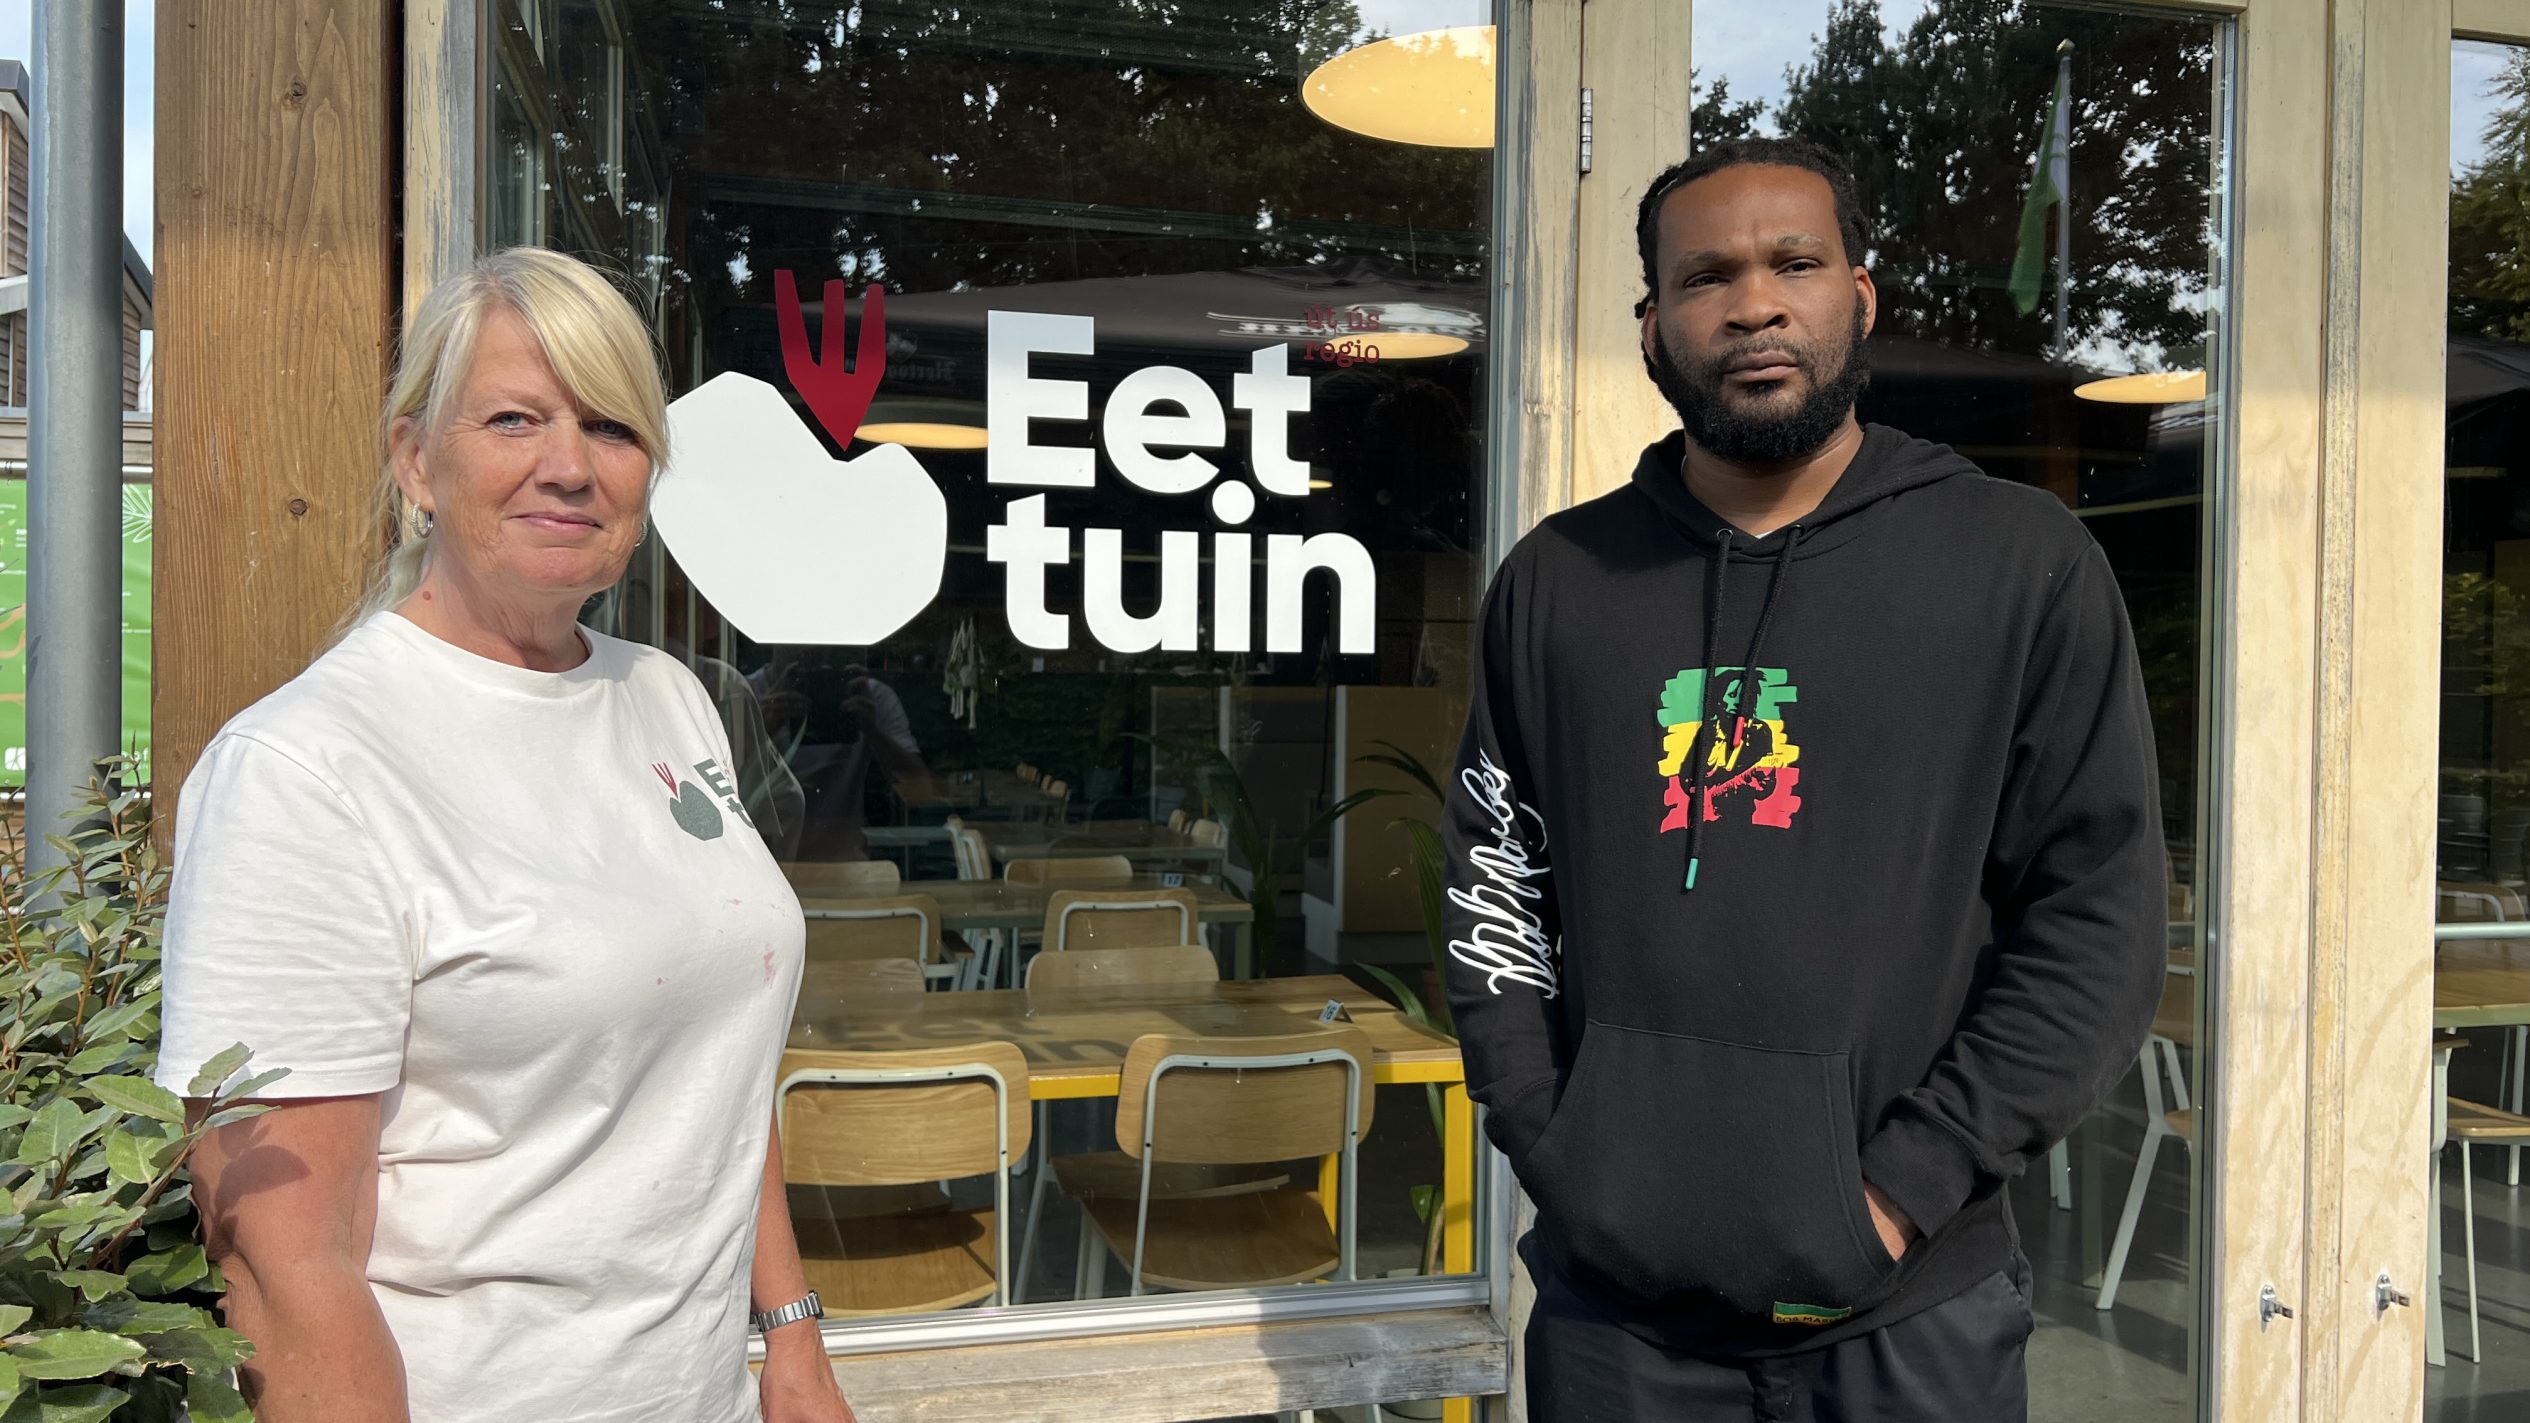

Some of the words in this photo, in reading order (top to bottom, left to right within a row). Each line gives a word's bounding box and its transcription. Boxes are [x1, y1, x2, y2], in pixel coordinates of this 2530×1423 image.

[987, 309, 1312, 496] Eet
[1303, 339, 1381, 368] regio
[987, 479, 1376, 654] tuin
